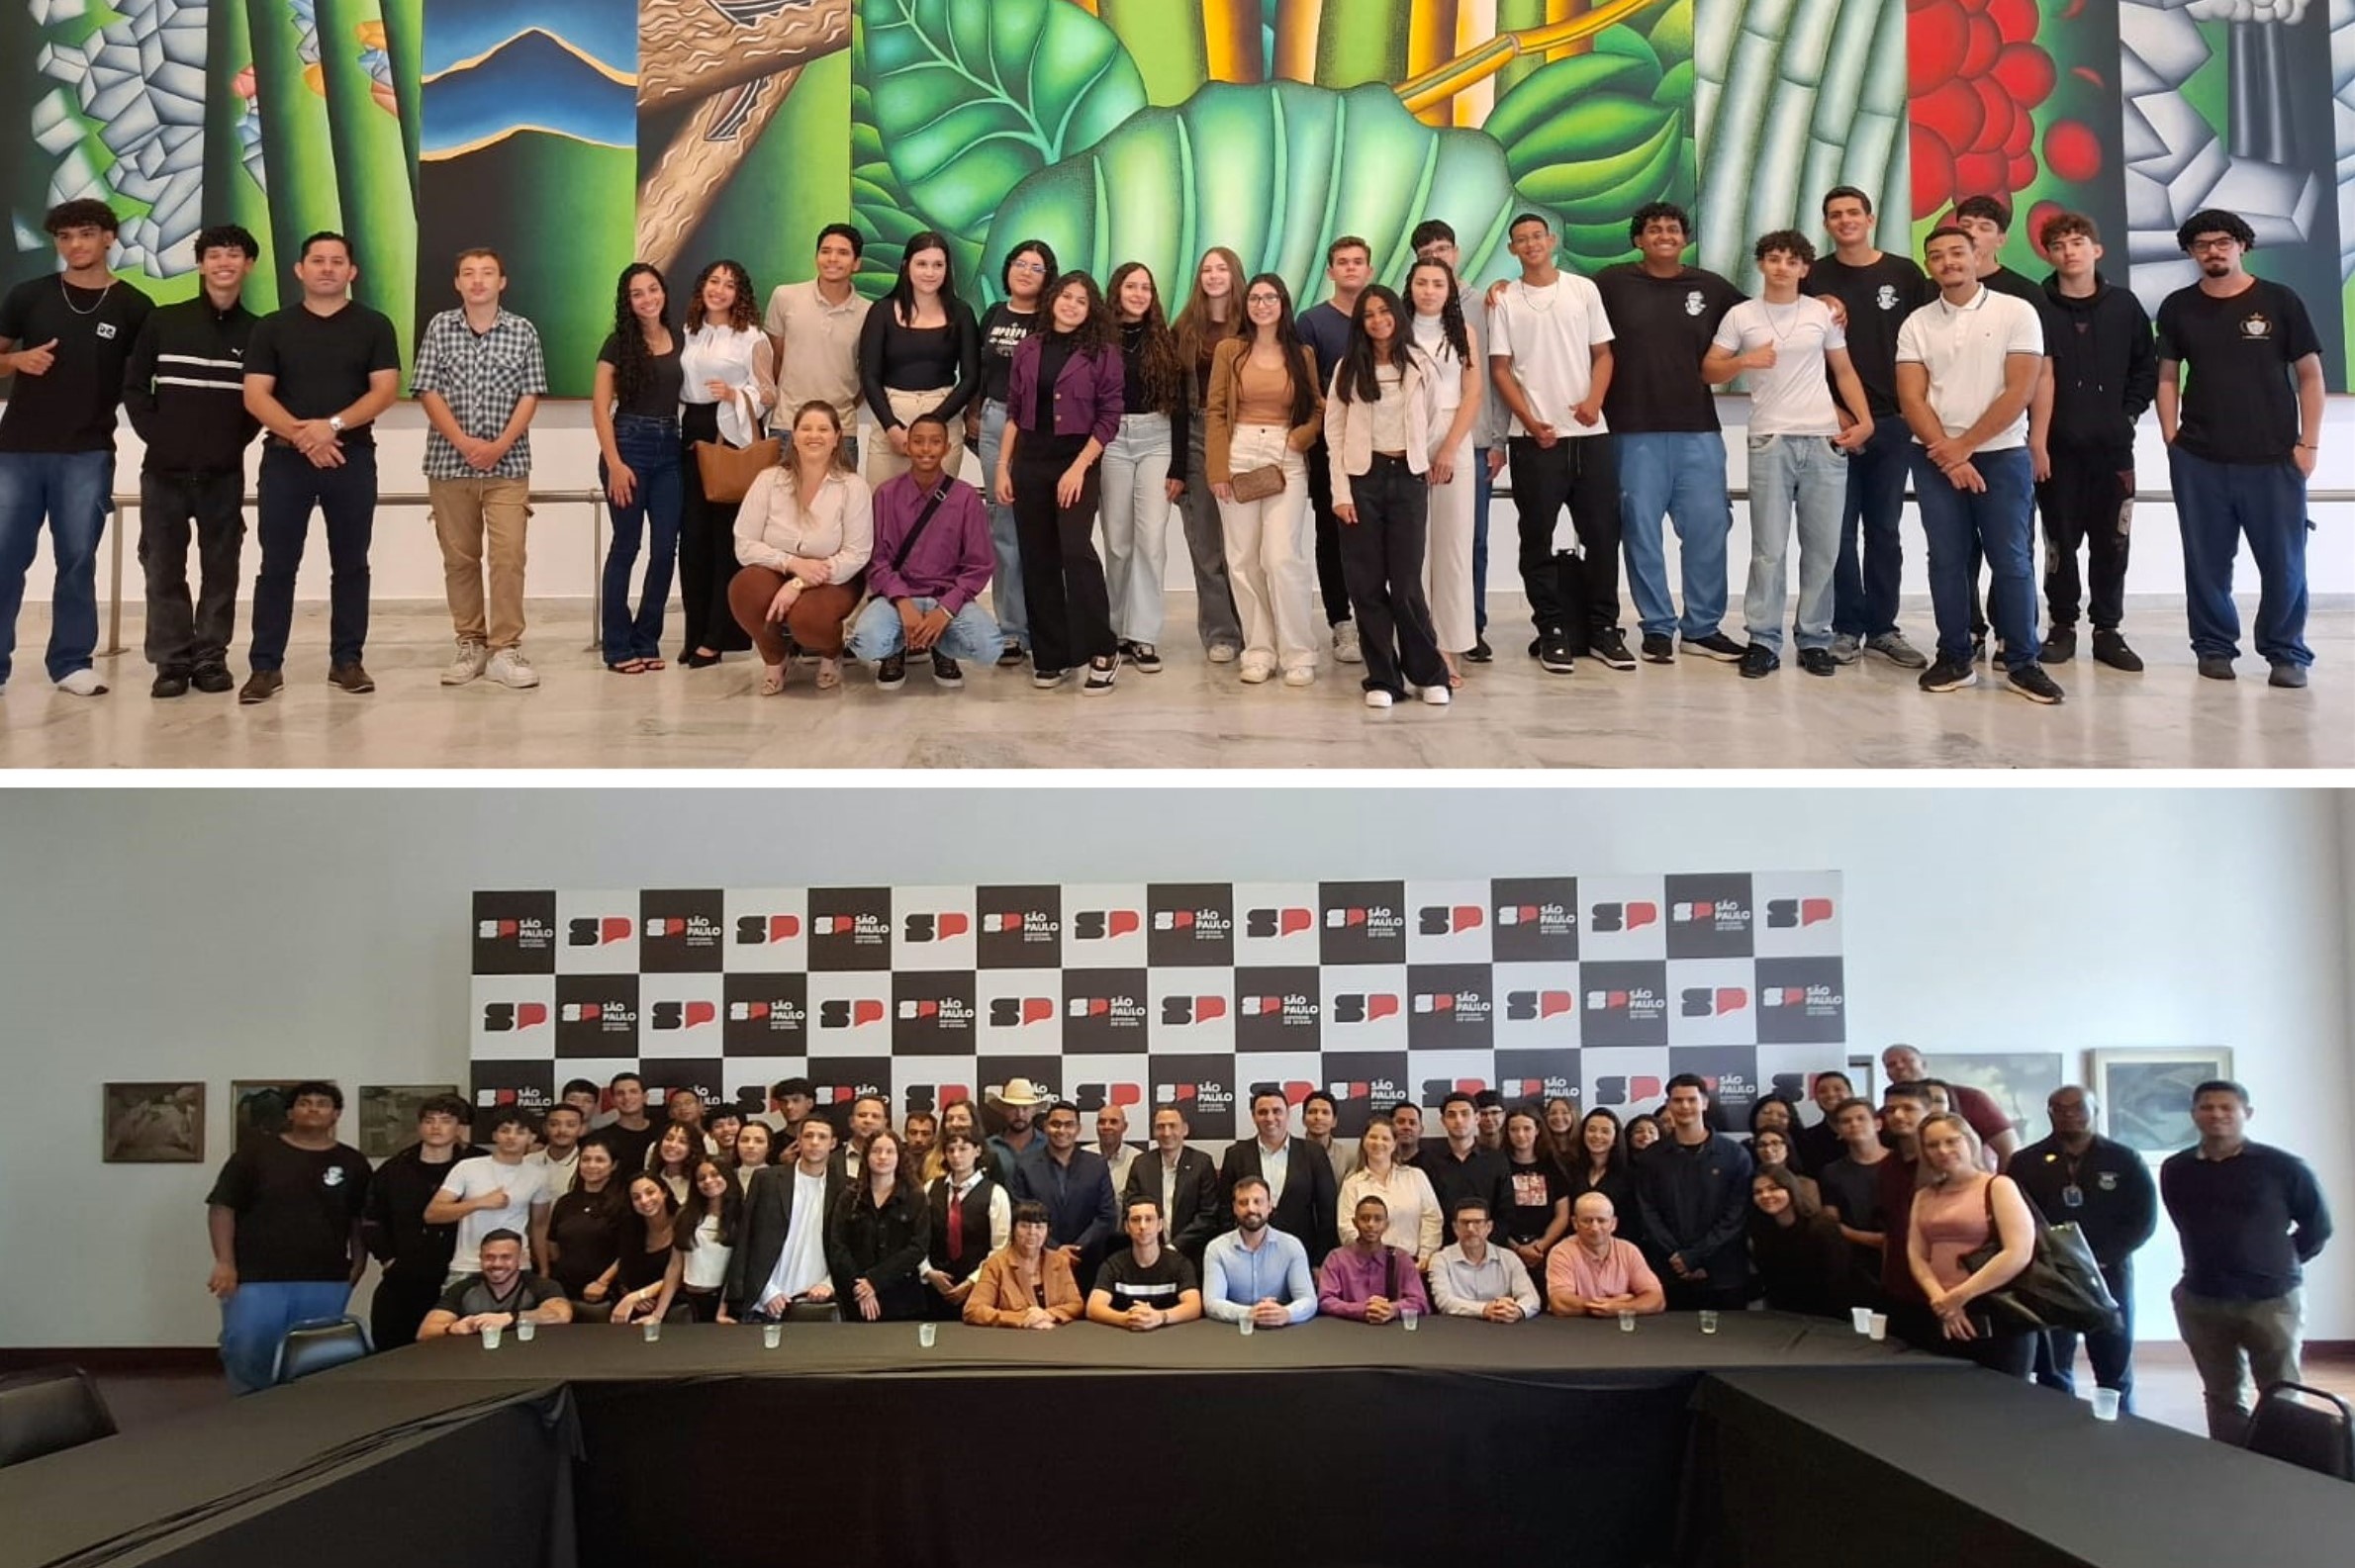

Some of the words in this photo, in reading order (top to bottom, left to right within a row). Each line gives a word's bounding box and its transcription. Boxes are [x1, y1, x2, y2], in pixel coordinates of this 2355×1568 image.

[1541, 904, 1563, 914] SÃO
[1716, 899, 1739, 910] SÃO
[1025, 911, 1048, 922] SÃO
[1196, 909, 1218, 920] SÃO
[1368, 906, 1391, 917] SÃO
[1716, 911, 1751, 920] PAULO
[519, 918, 541, 928] SÃO
[687, 917, 709, 927] SÃO
[856, 914, 878, 924] SÃO
[1541, 915, 1576, 924] PAULO
[1196, 921, 1231, 930] PAULO
[519, 929, 553, 938] PAULO
[687, 928, 721, 937] PAULO
[1629, 988, 1651, 999] SÃO
[1806, 985, 1829, 995] SÃO
[1110, 996, 1133, 1006] SÃO
[1283, 994, 1306, 1004] SÃO
[1456, 991, 1478, 1002] SÃO
[1806, 996, 1841, 1005] PAULO
[603, 1001, 624, 1012] SÃO
[771, 1000, 793, 1010] SÃO
[940, 998, 962, 1008] SÃO
[1456, 1003, 1491, 1012] PAULO
[1629, 1000, 1664, 1009] PAULO
[940, 1009, 975, 1018] PAULO
[1283, 1005, 1318, 1014] PAULO
[603, 1013, 637, 1022] PAULO
[1545, 1076, 1567, 1087] SÃO
[1720, 1073, 1743, 1084] SÃO
[1197, 1081, 1221, 1092] SÃO
[1371, 1080, 1393, 1090] SÃO
[1720, 1084, 1755, 1094] PAULO
[518, 1086, 540, 1096] SÃO
[1371, 1091, 1406, 1100] PAULO
[1197, 1092, 1233, 1102] PAULO
